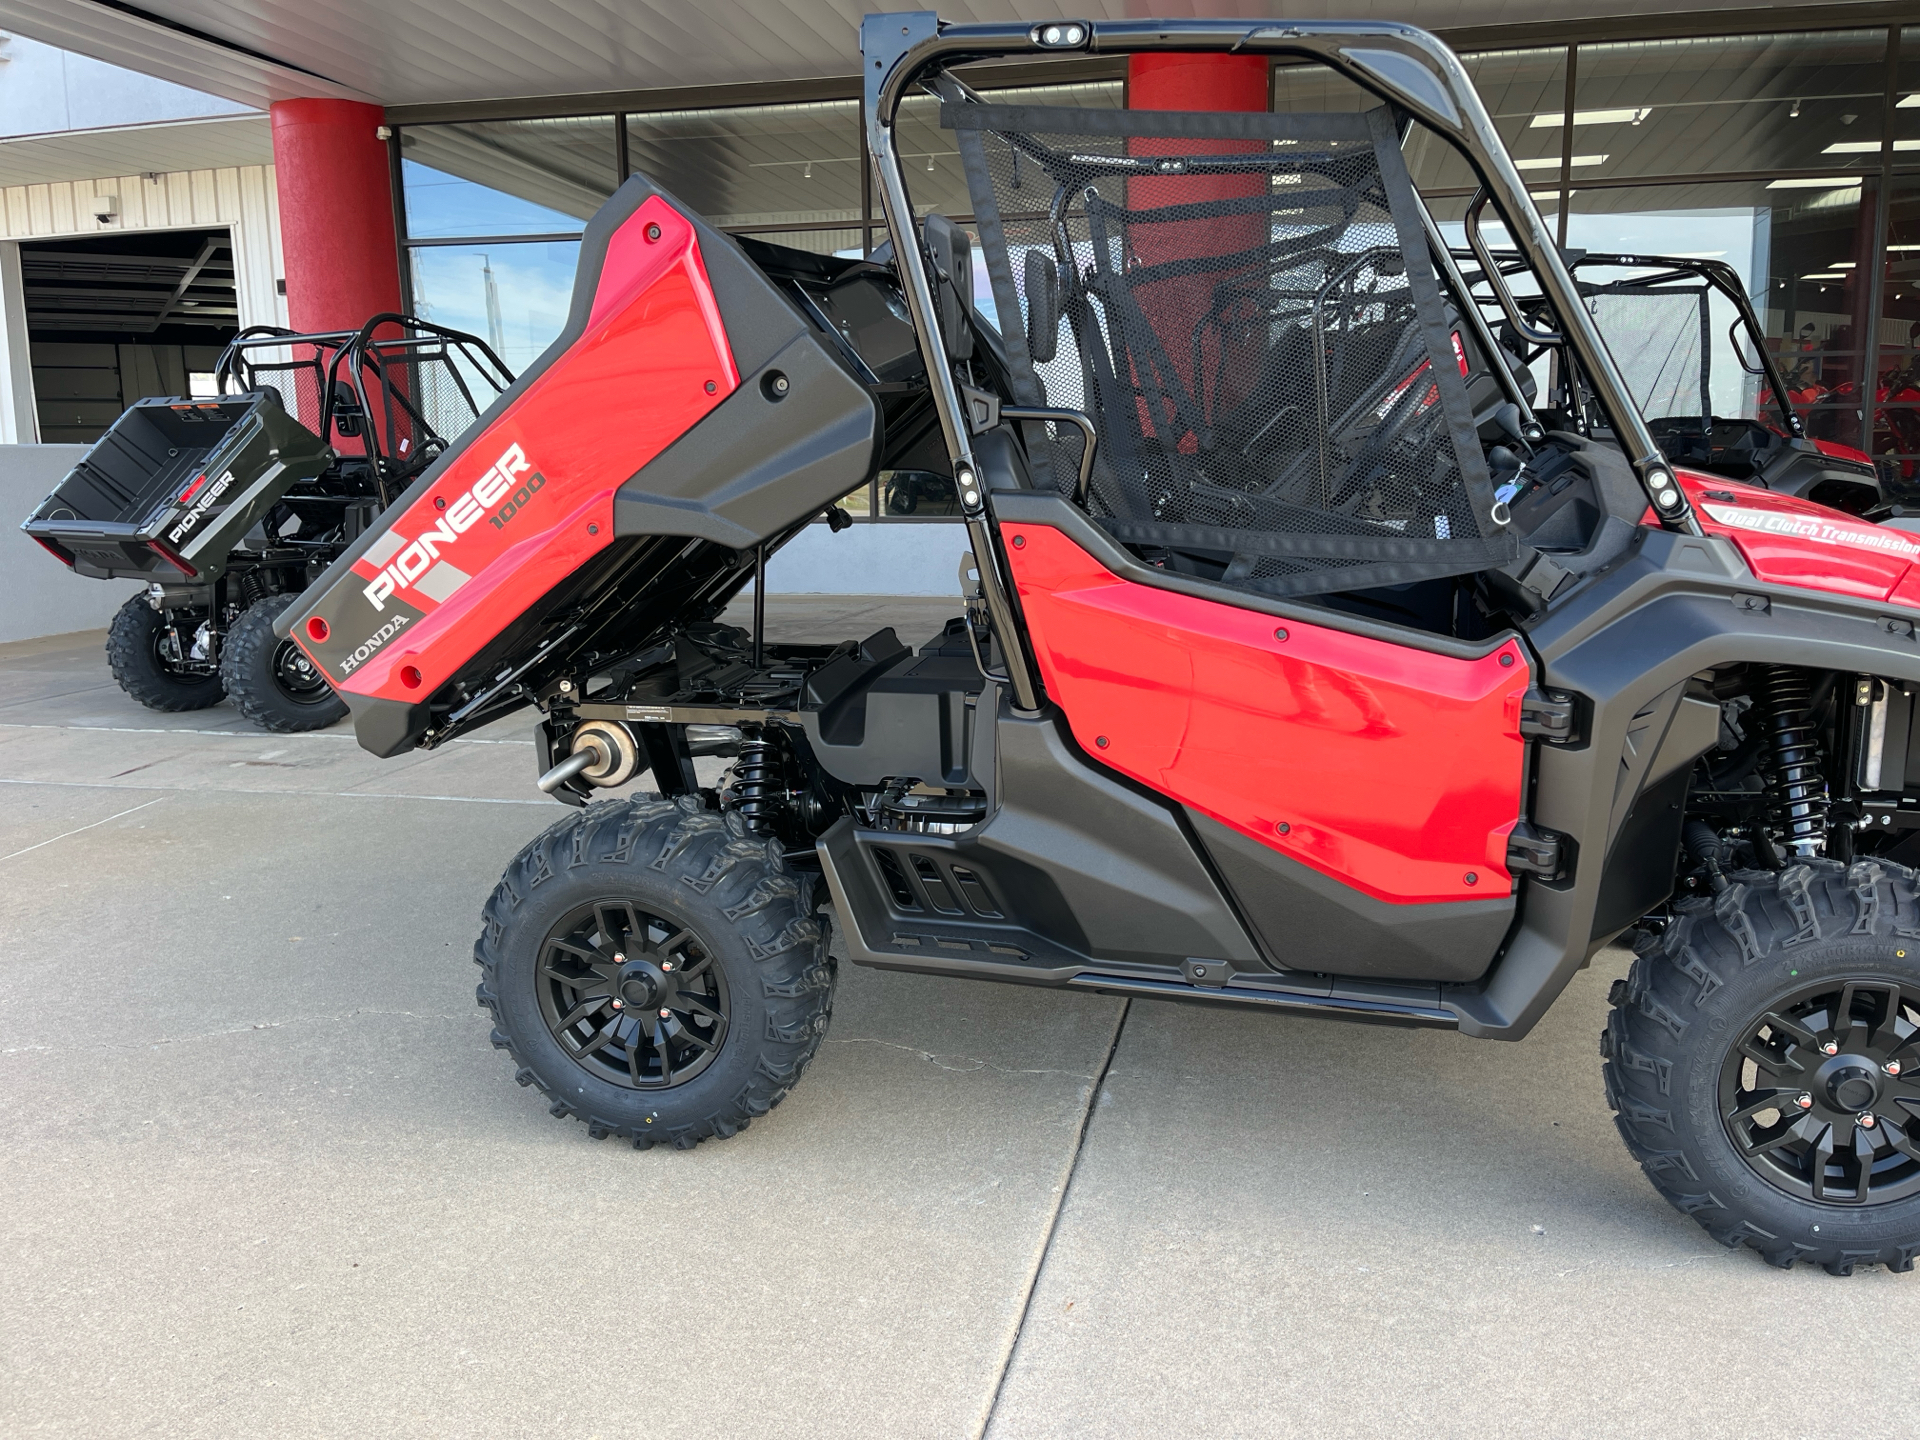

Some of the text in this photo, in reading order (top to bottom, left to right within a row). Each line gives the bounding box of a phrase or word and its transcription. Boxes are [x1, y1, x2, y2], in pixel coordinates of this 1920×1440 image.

[168, 470, 235, 544] PIONEER
[362, 441, 531, 612] PIONEER
[489, 471, 546, 531] 1000
[1721, 510, 1920, 555] Dual Clutch Transmission
[339, 614, 410, 675] HONDA
